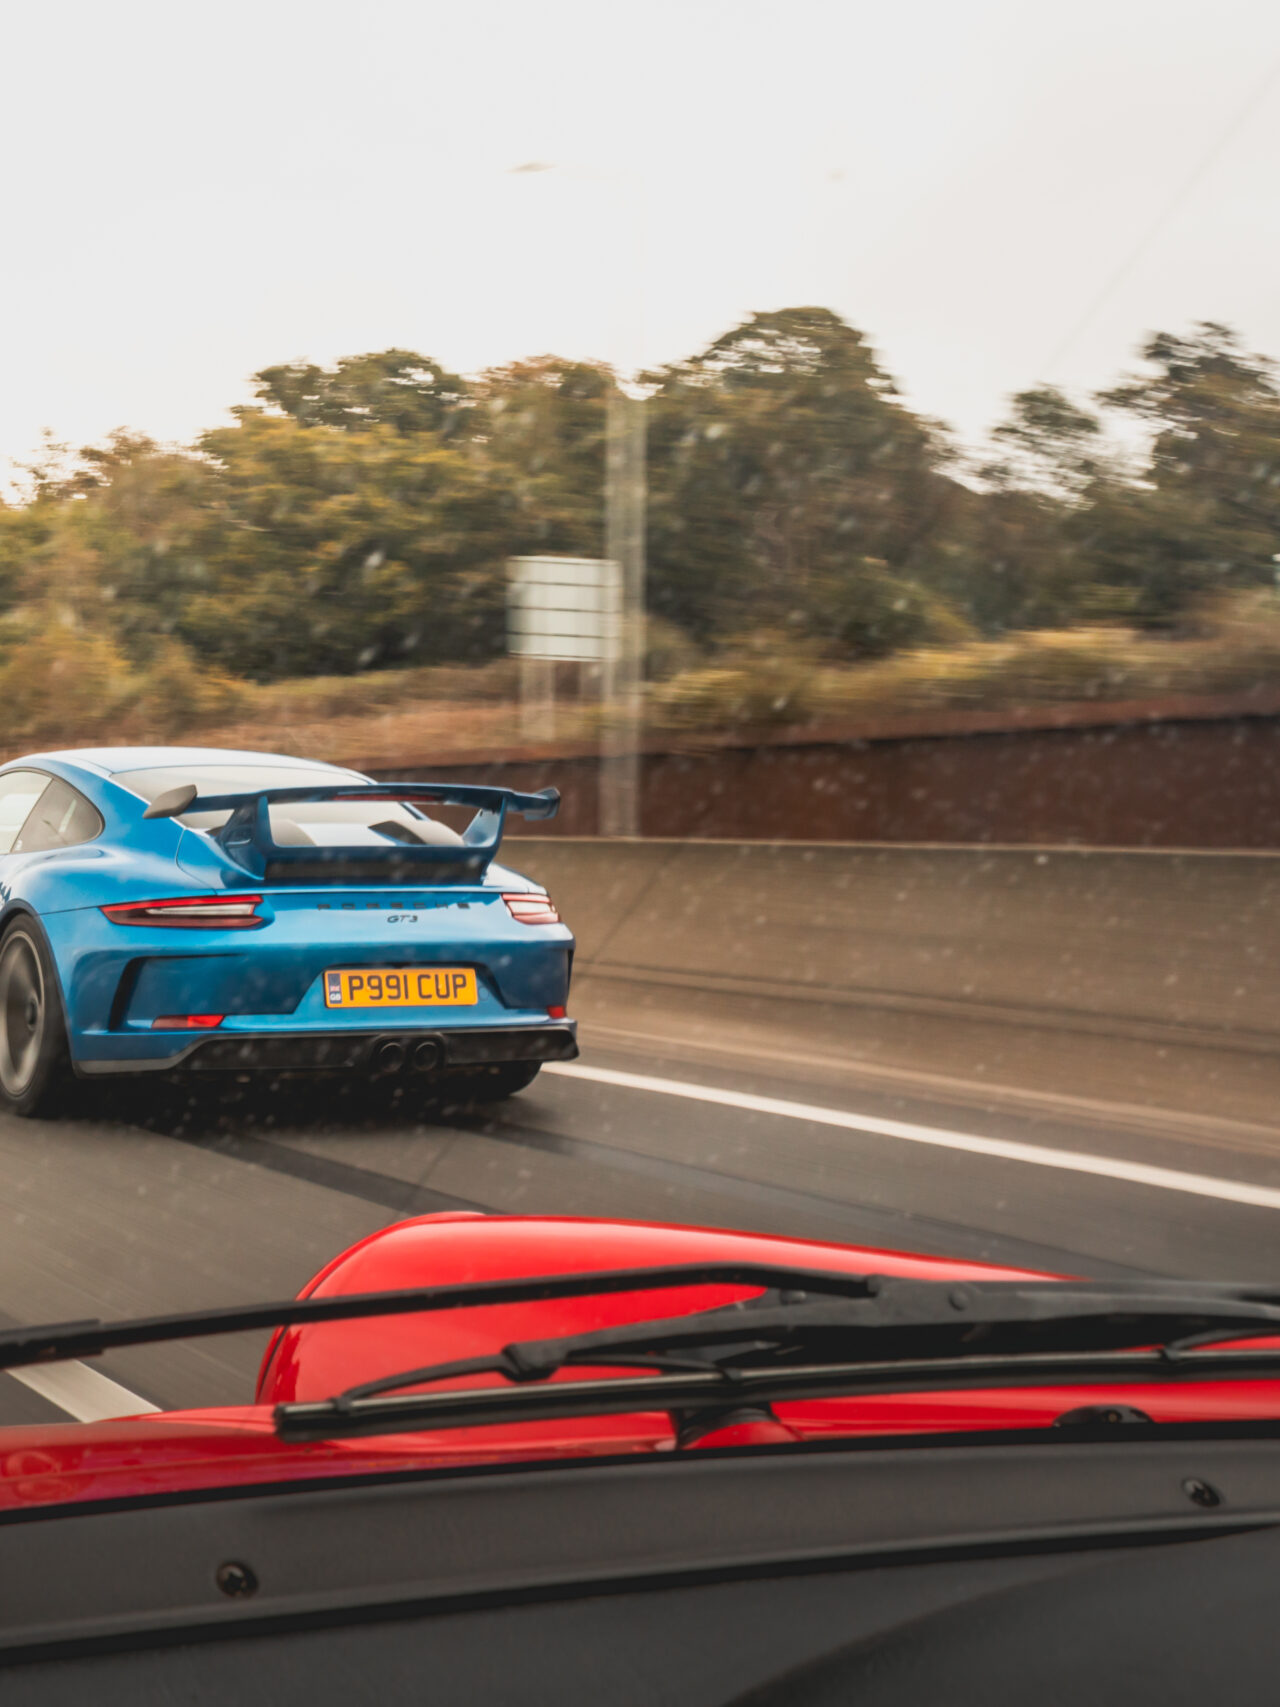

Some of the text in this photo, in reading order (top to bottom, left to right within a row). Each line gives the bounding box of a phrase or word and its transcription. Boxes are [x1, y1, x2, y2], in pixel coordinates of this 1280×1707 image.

[318, 902, 470, 910] PORSCHE
[387, 915, 418, 923] GT3
[348, 973, 467, 1001] P991 CUP
